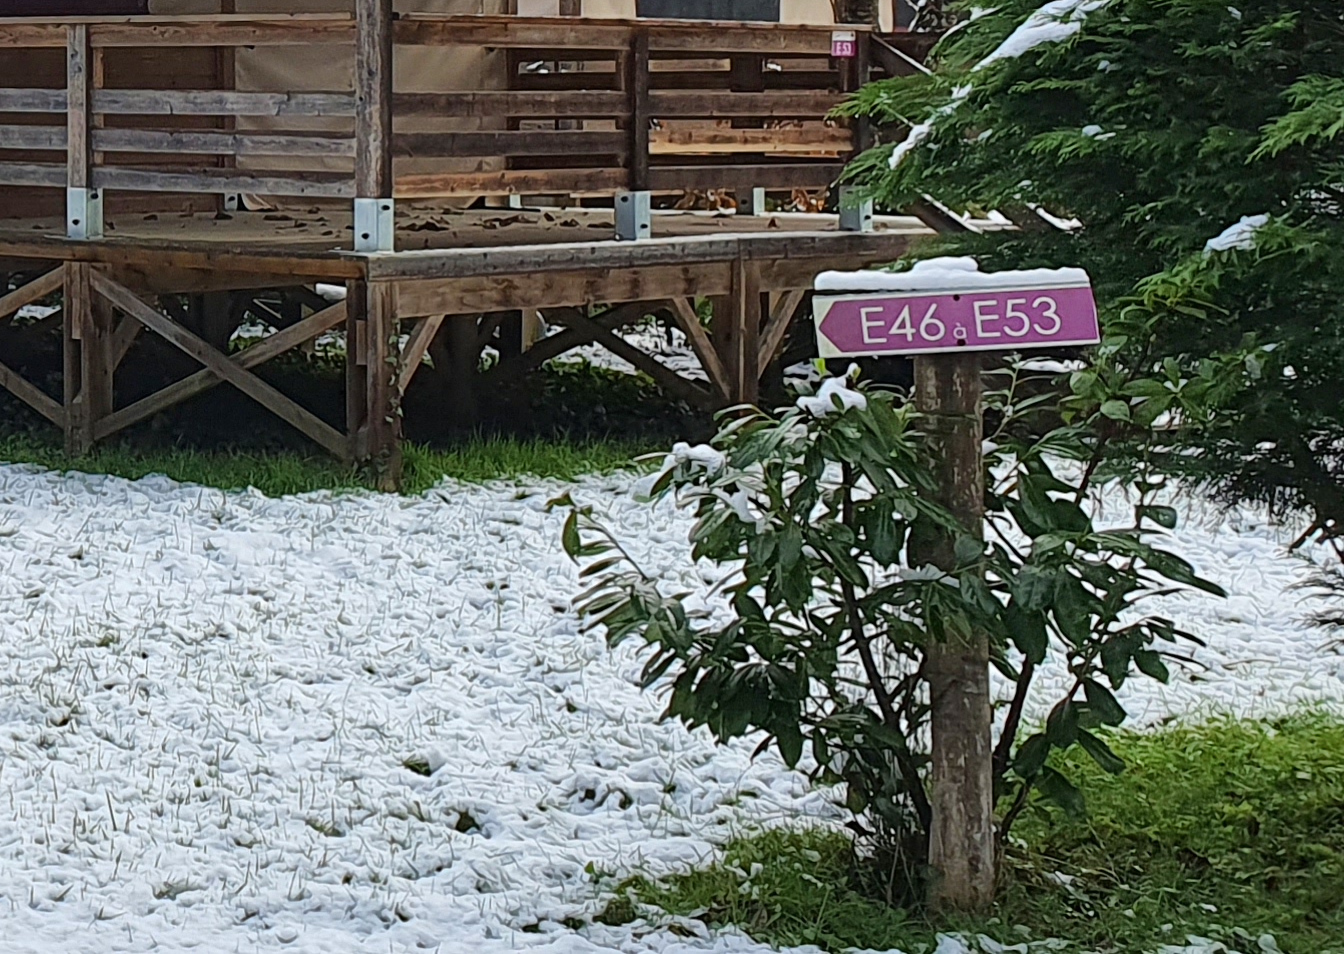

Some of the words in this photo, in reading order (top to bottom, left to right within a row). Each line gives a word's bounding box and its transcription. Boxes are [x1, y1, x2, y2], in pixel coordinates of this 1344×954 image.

[859, 303, 946, 344] E46
[952, 322, 968, 340] à
[973, 296, 1062, 338] E53
